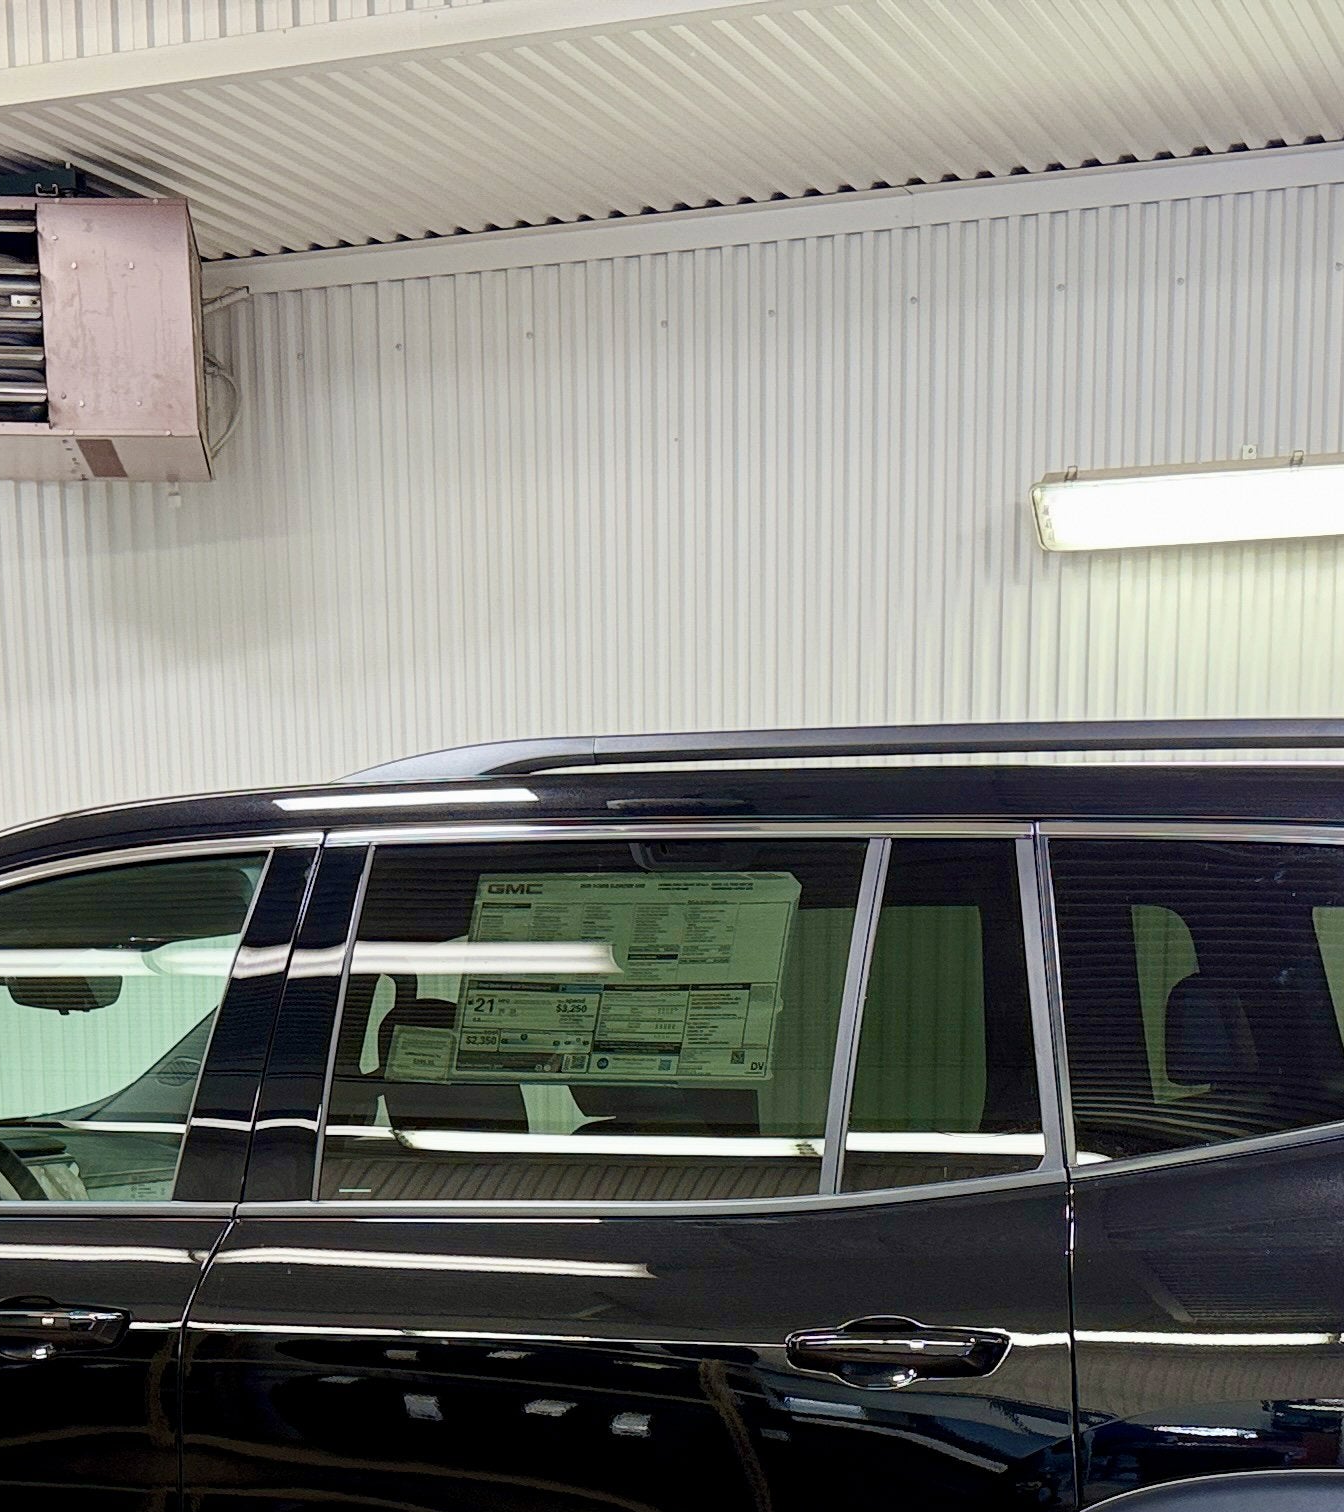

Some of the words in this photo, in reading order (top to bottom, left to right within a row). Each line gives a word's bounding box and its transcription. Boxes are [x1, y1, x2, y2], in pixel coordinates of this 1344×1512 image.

[488, 883, 543, 895] GMC
[474, 998, 495, 1012] 21
[750, 1061, 765, 1071] DV
